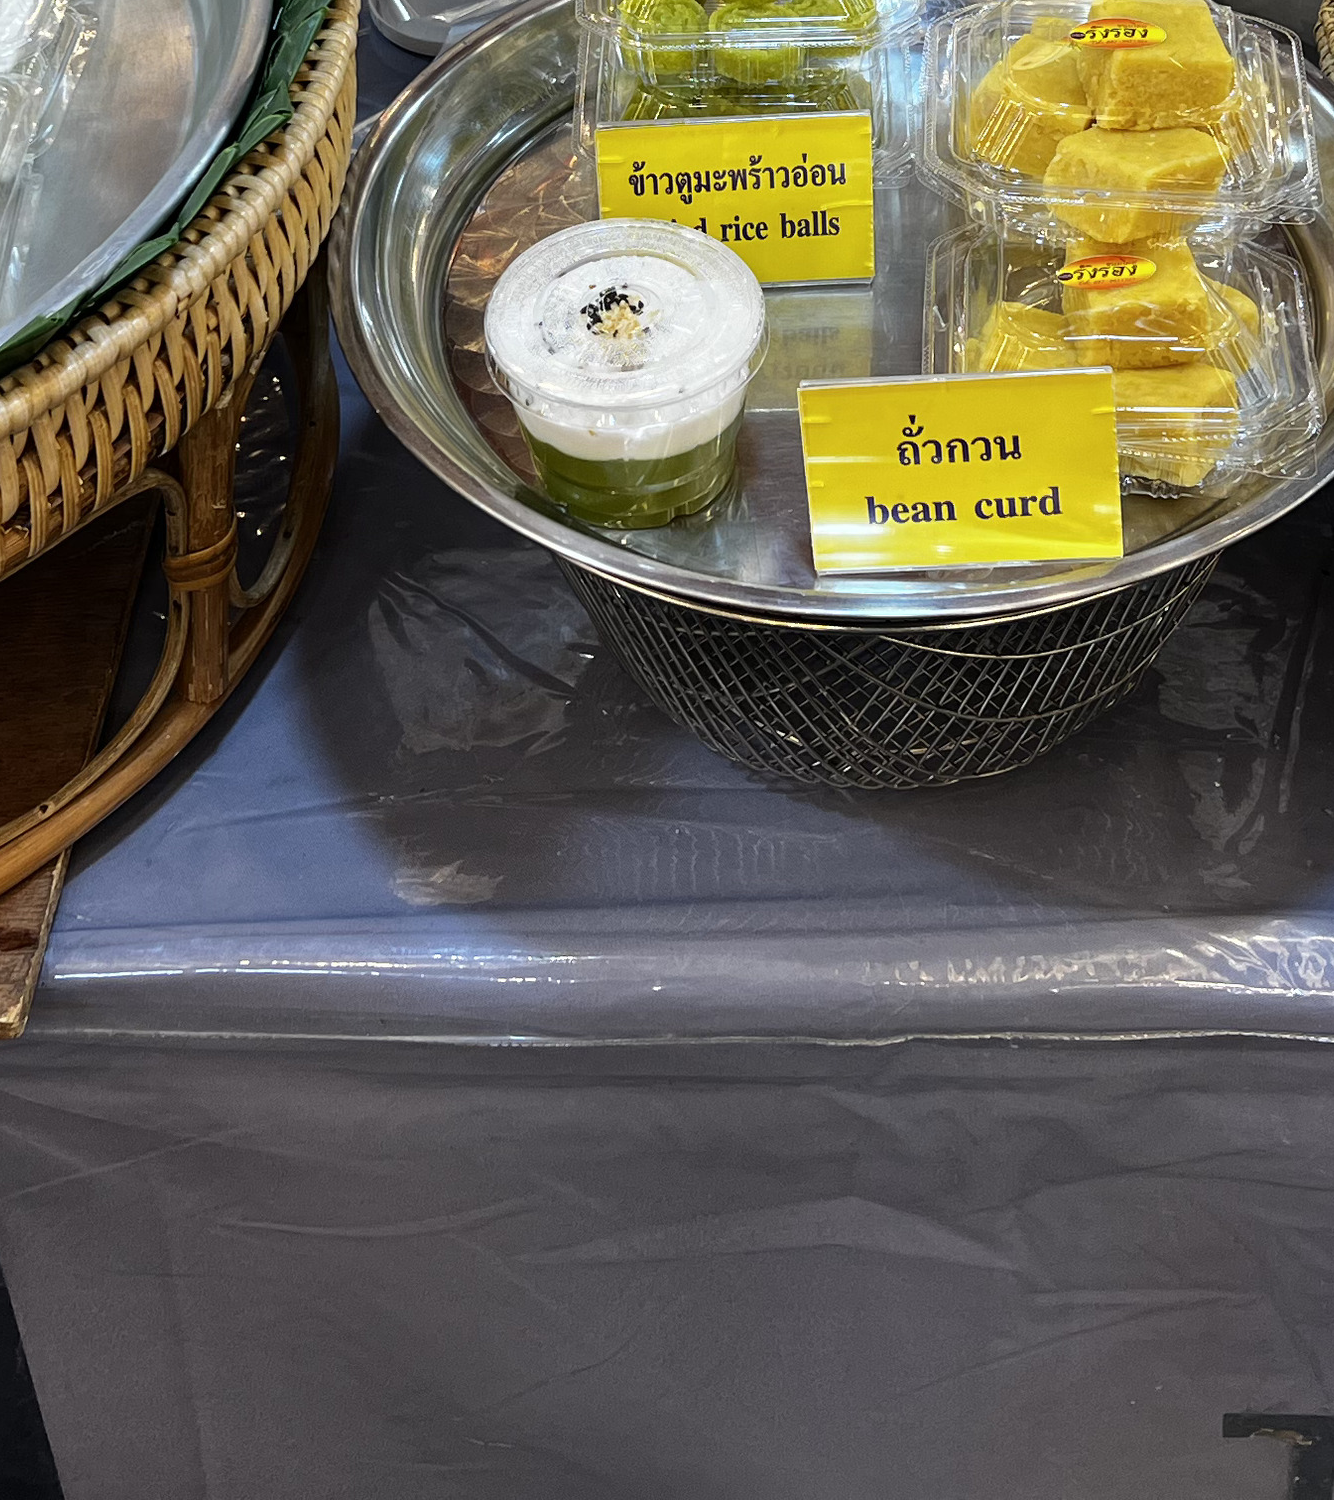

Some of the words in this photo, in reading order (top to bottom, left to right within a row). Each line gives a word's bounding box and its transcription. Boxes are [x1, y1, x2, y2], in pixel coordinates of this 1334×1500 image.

[628, 153, 847, 205] ข้าวตูมะพร้าวอ่อน
[720, 215, 769, 242] rice
[780, 211, 841, 239] balls
[897, 414, 1022, 466] ถั่วกวน
[864, 496, 957, 525] bean
[974, 486, 1063, 520] curd
